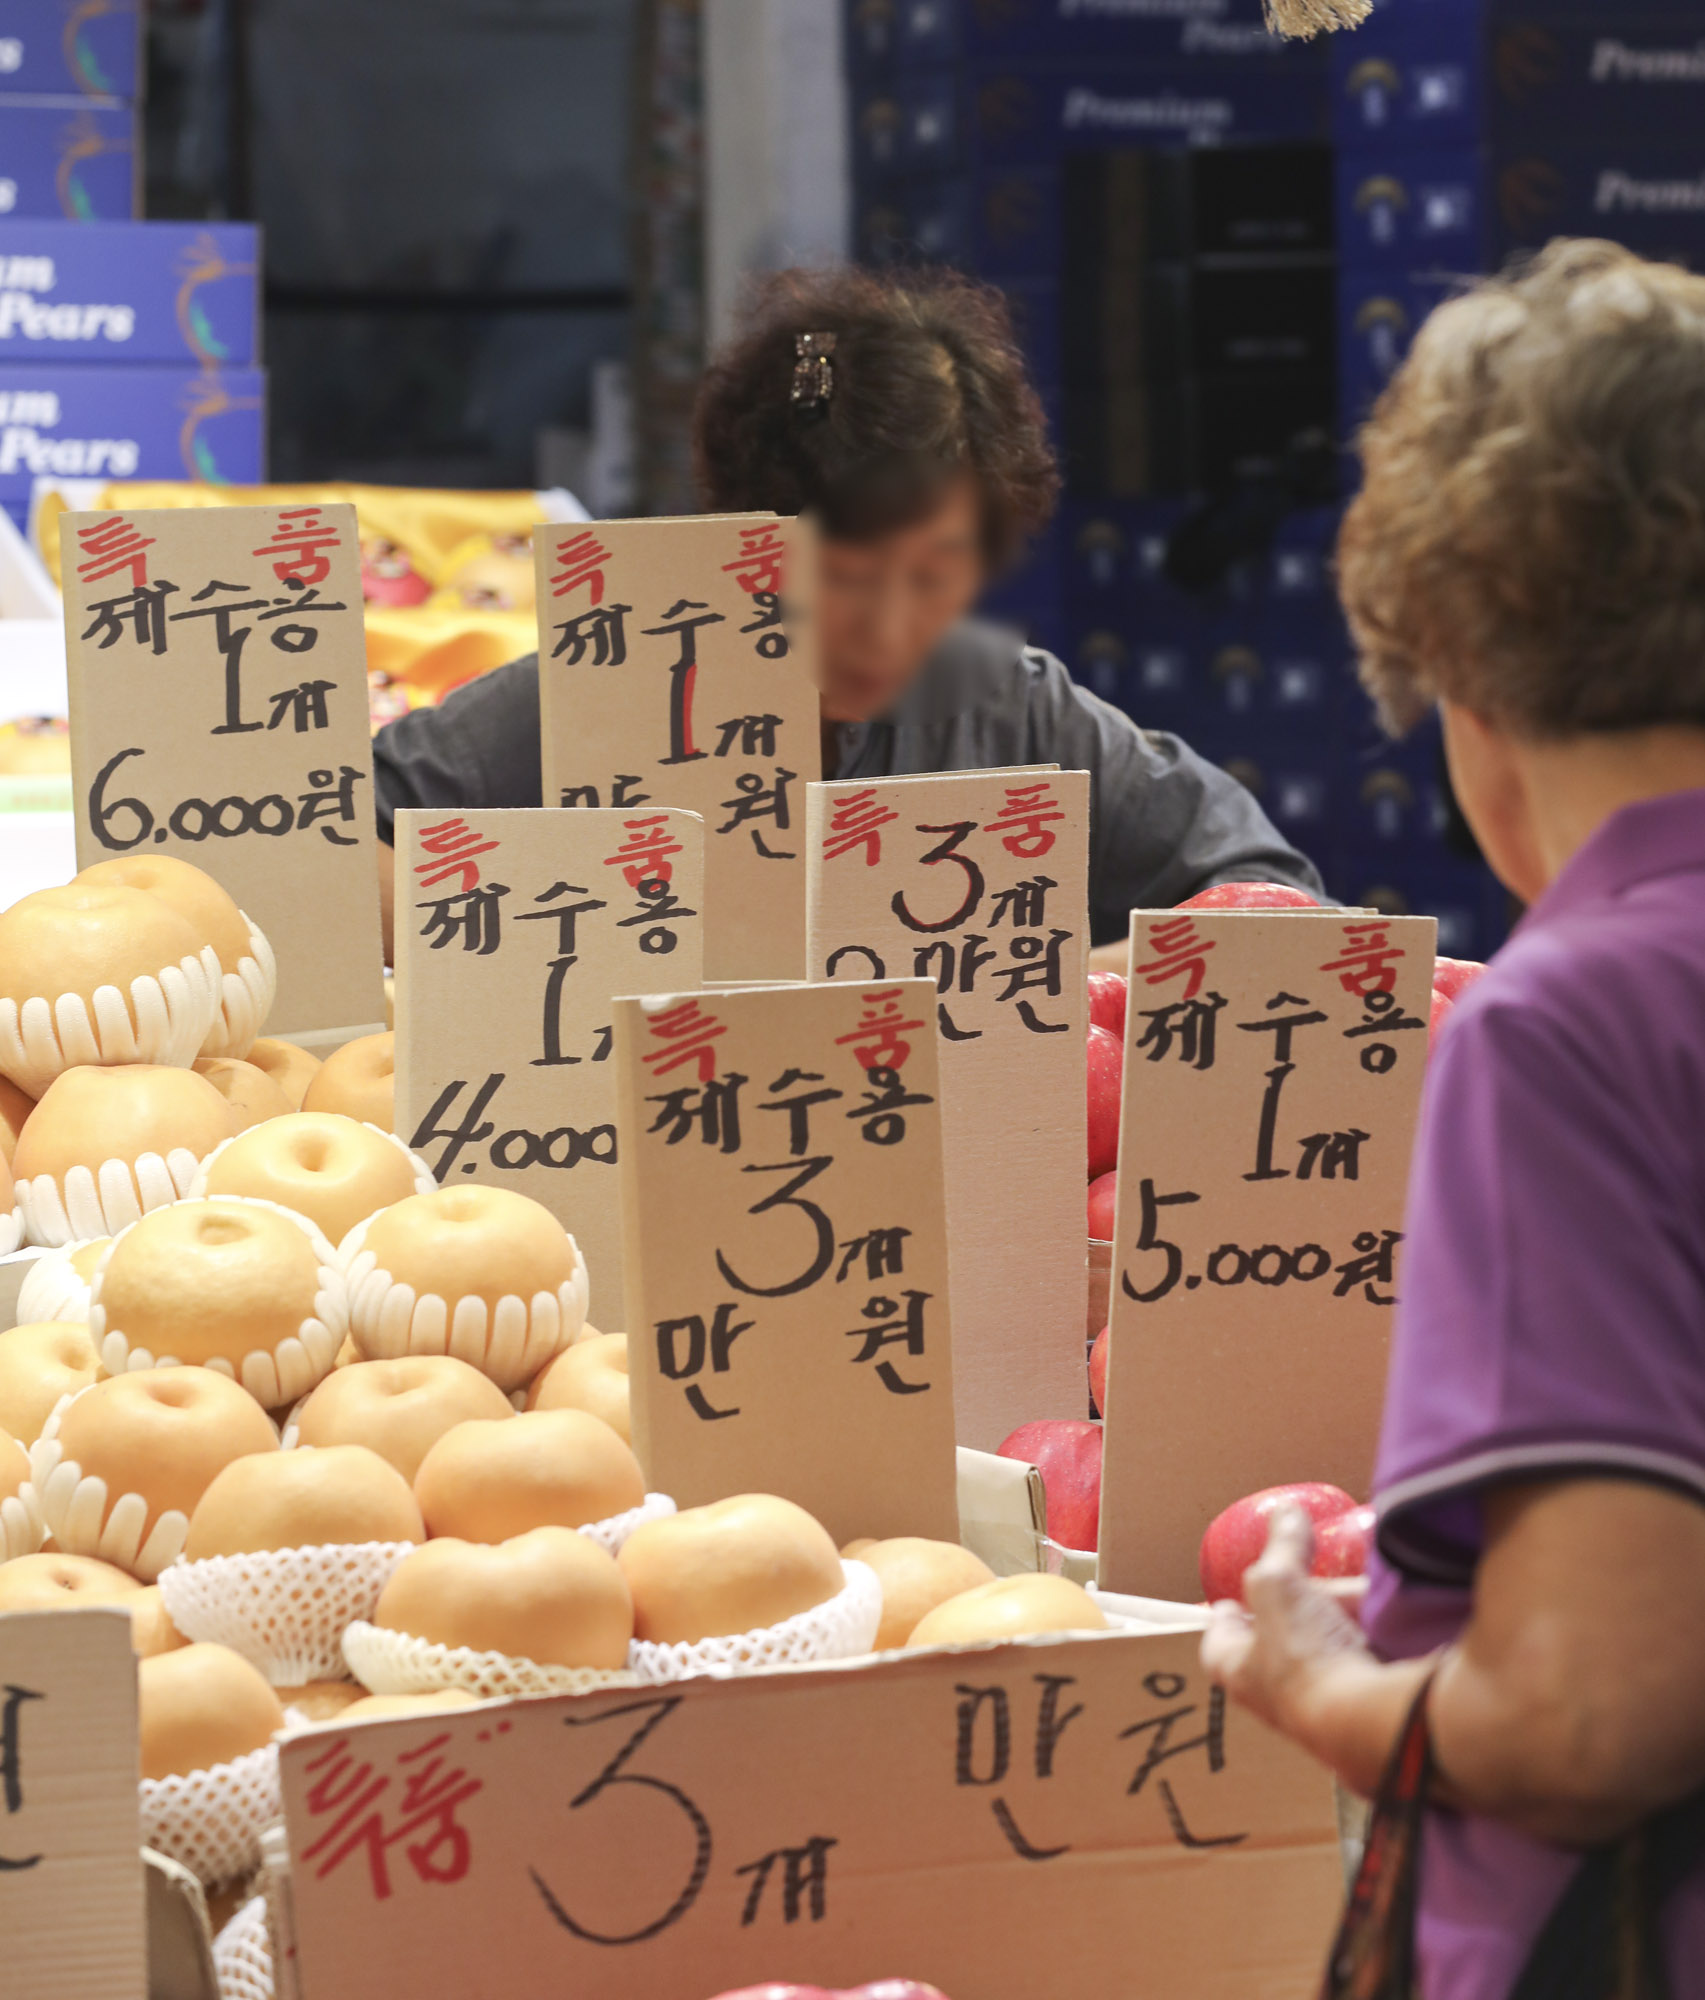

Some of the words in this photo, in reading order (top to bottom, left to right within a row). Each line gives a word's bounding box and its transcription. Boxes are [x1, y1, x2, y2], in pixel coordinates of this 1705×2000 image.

[0, 291, 135, 342] Pears
[0, 426, 139, 476] Pears
[81, 577, 347, 655] 제수용
